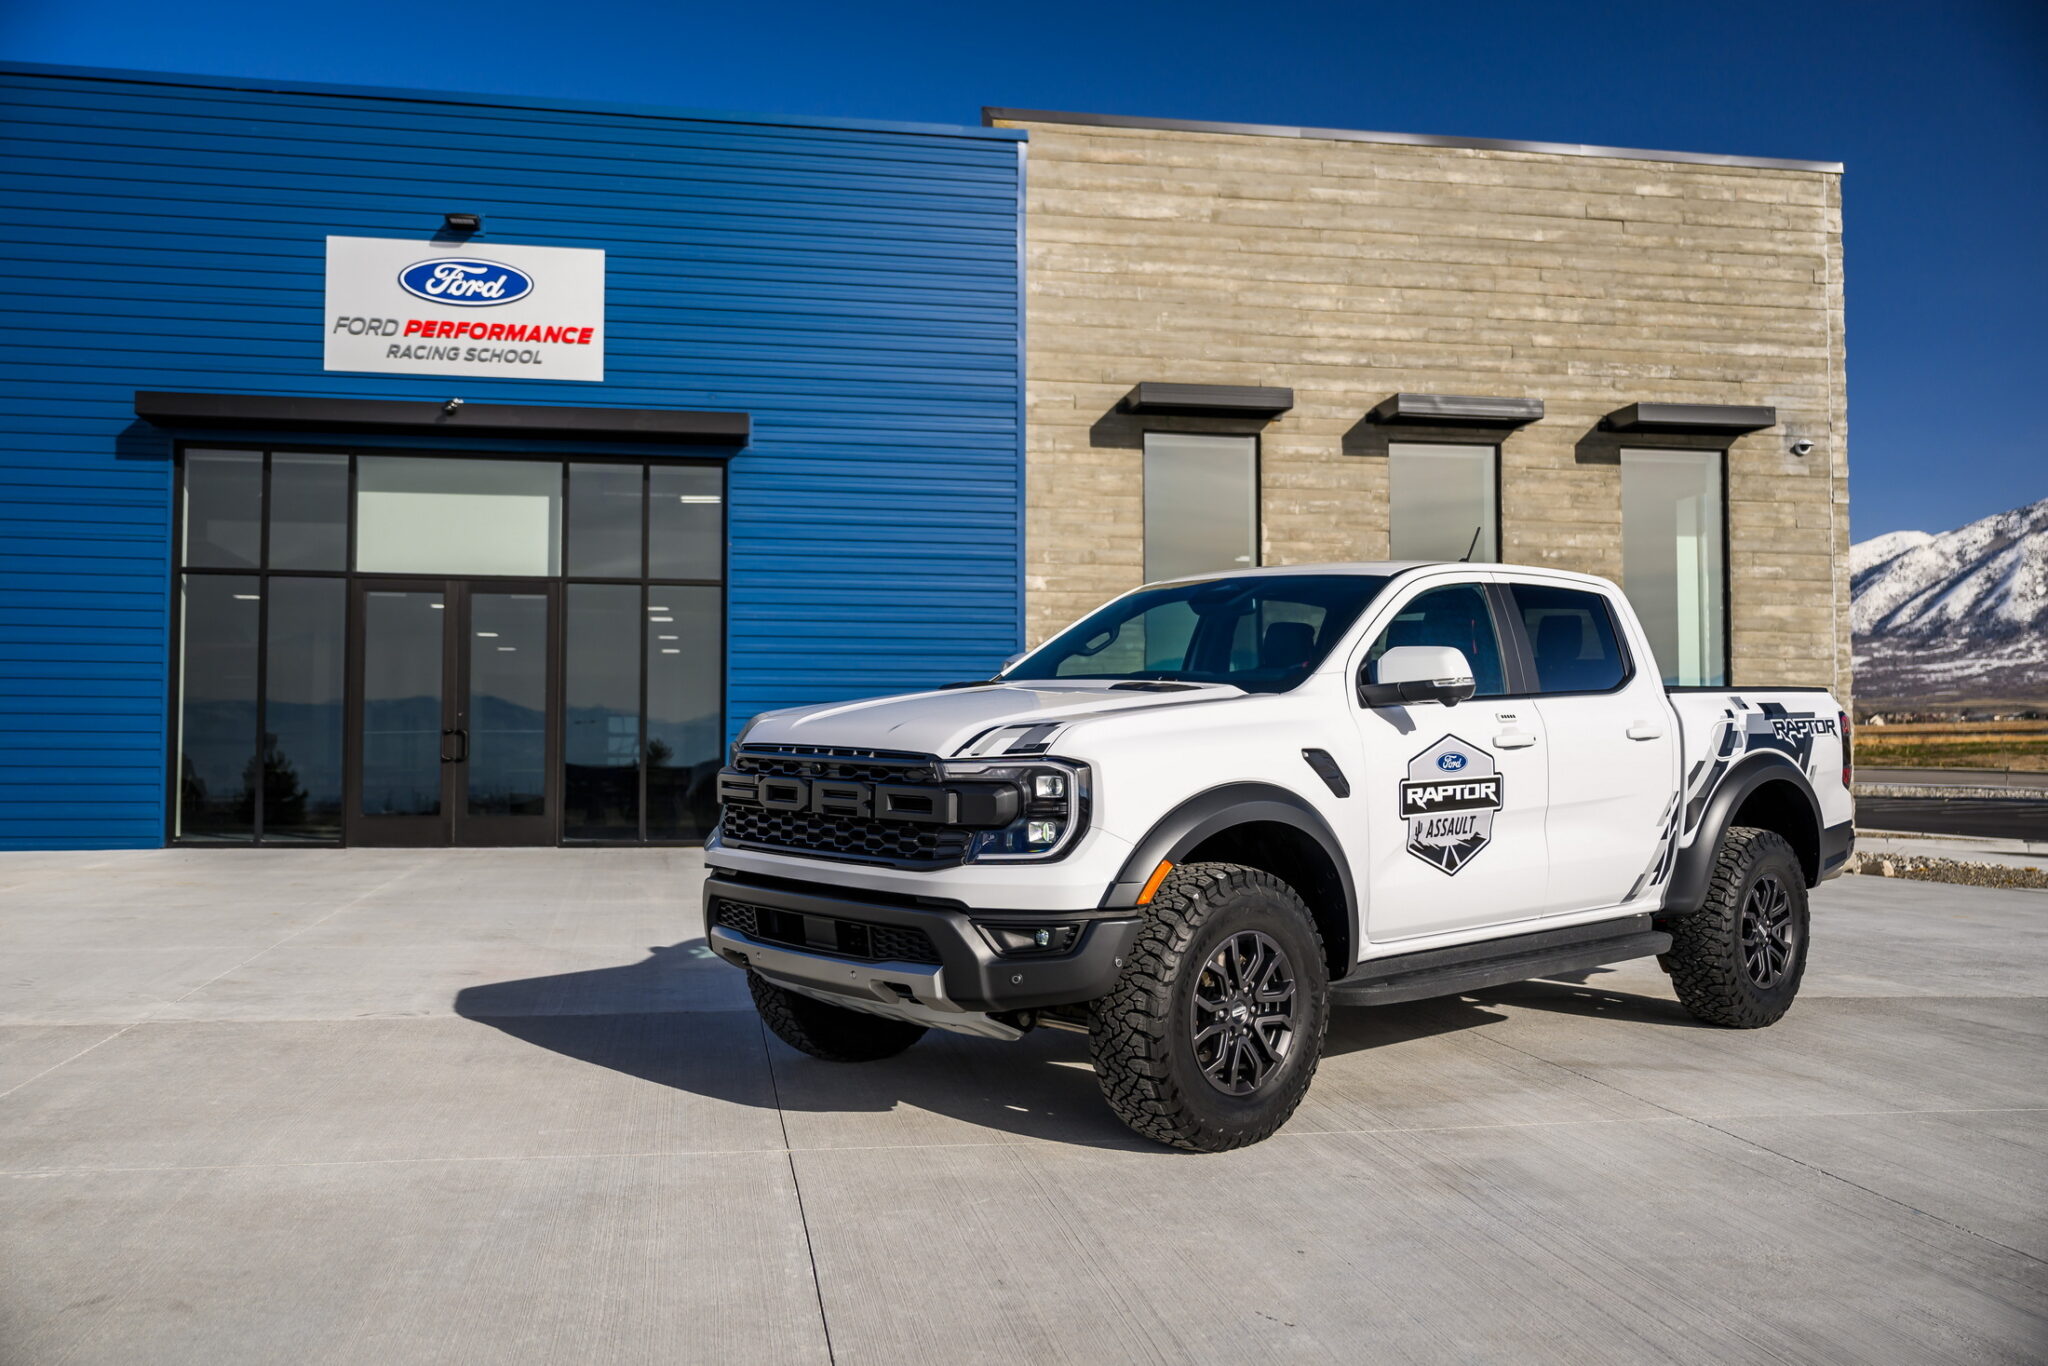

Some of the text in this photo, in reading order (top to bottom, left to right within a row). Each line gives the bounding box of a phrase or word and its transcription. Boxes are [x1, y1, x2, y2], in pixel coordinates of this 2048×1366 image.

[424, 262, 508, 299] Ford
[332, 316, 594, 346] FORD PERFORMANCE
[386, 344, 543, 365] RACING SCHOOL
[1770, 719, 1841, 747] RAPTOR
[1442, 755, 1462, 769] Ford
[717, 768, 957, 825] FORD
[1406, 782, 1499, 810] RAPTOR
[1425, 815, 1477, 839] ASSAULT
